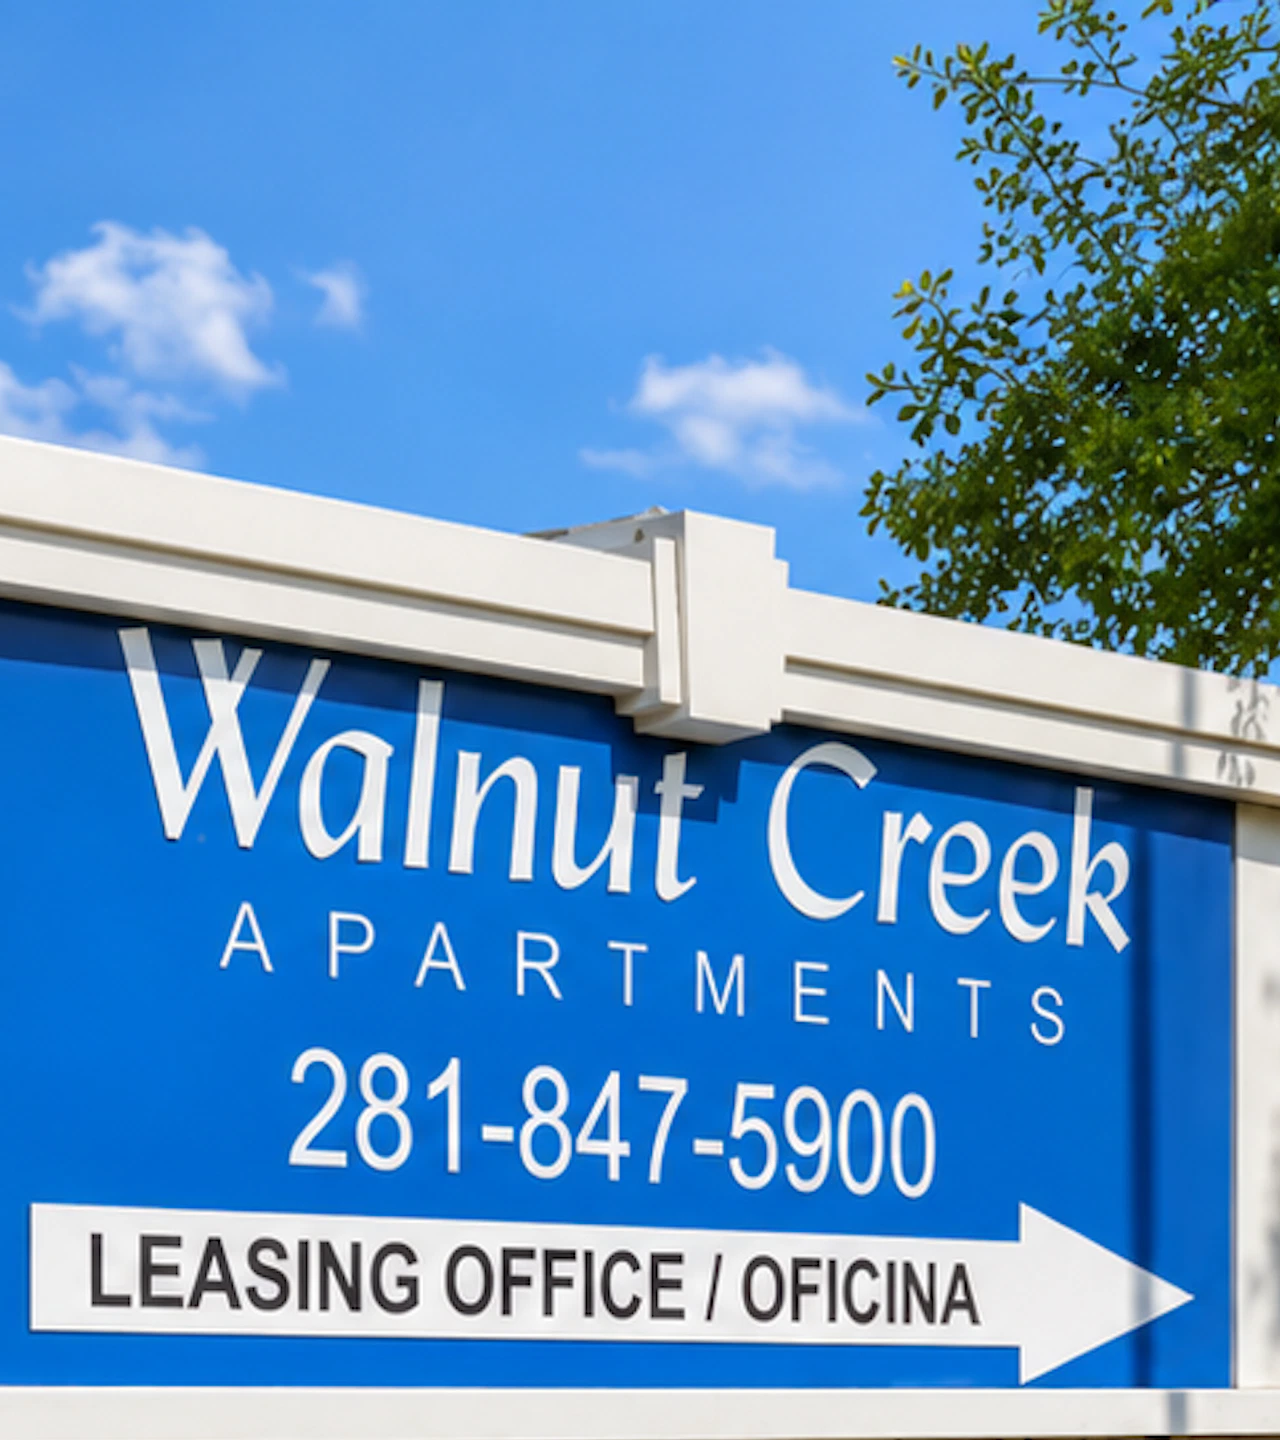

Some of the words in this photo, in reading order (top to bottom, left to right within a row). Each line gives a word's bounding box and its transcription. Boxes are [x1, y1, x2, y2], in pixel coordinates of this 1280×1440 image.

[120, 628, 702, 901] Walnut
[768, 744, 1129, 952] Creek
[220, 903, 1063, 1045] APARTMENTS
[289, 1048, 935, 1198] 281-847-5900
[91, 1234, 418, 1313] LEASING
[446, 1246, 684, 1319] OFFICE
[743, 1256, 979, 1324] OFICINA
